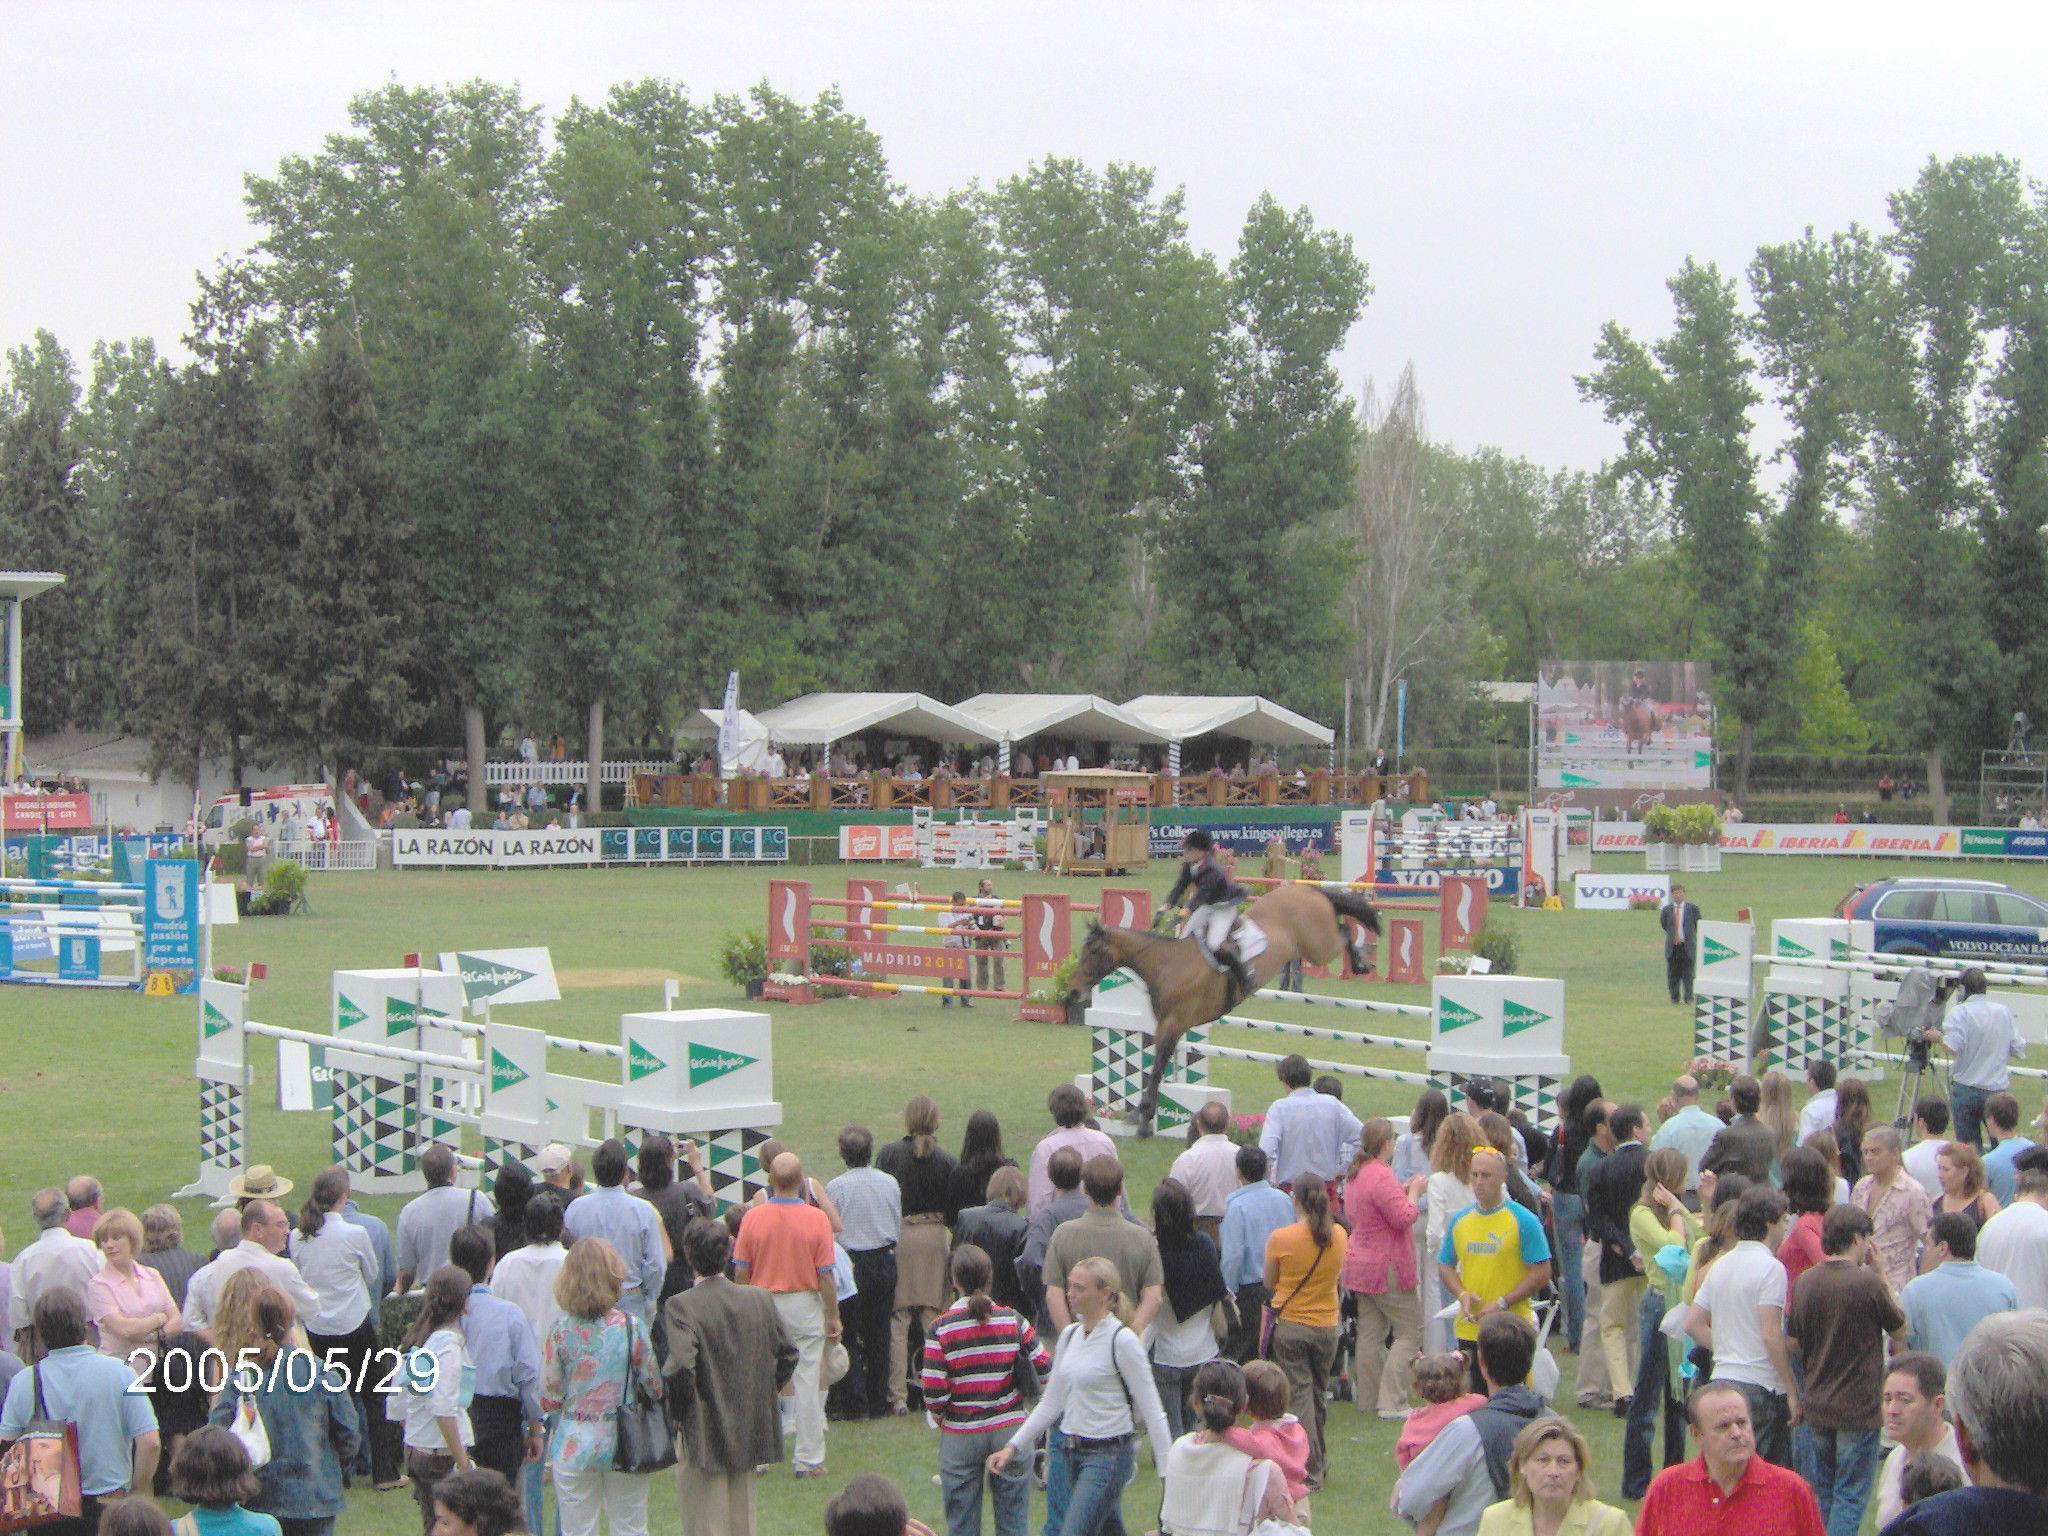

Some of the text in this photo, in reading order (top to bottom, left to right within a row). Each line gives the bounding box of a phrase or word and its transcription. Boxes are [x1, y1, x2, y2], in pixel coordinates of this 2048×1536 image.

[604, 831, 626, 845] AC
[636, 831, 660, 845] AC
[669, 830, 693, 844] AC
[700, 830, 722, 844] AC
[731, 830, 754, 844] AC
[763, 830, 785, 844] AC
[1210, 825, 1323, 843] www.kingscollege.es
[1596, 834, 1646, 846] IBER
[399, 836, 493, 855] LA RAZÓN
[504, 835, 594, 856] LA RAZÓN
[1720, 835, 1748, 848] RIA
[1779, 837, 1839, 849] IBERIA
[1870, 838, 1931, 850] IBERIA
[1393, 869, 1504, 889] VOO
[1578, 886, 1666, 899] VOLVO
[153, 921, 188, 930] madrid
[151, 931, 189, 942] pasión
[151, 944, 173, 954] por
[1949, 940, 2048, 955] VOLVO OCEAN RA
[147, 955, 194, 966] deporte
[863, 951, 966, 970] MADRID 2012
